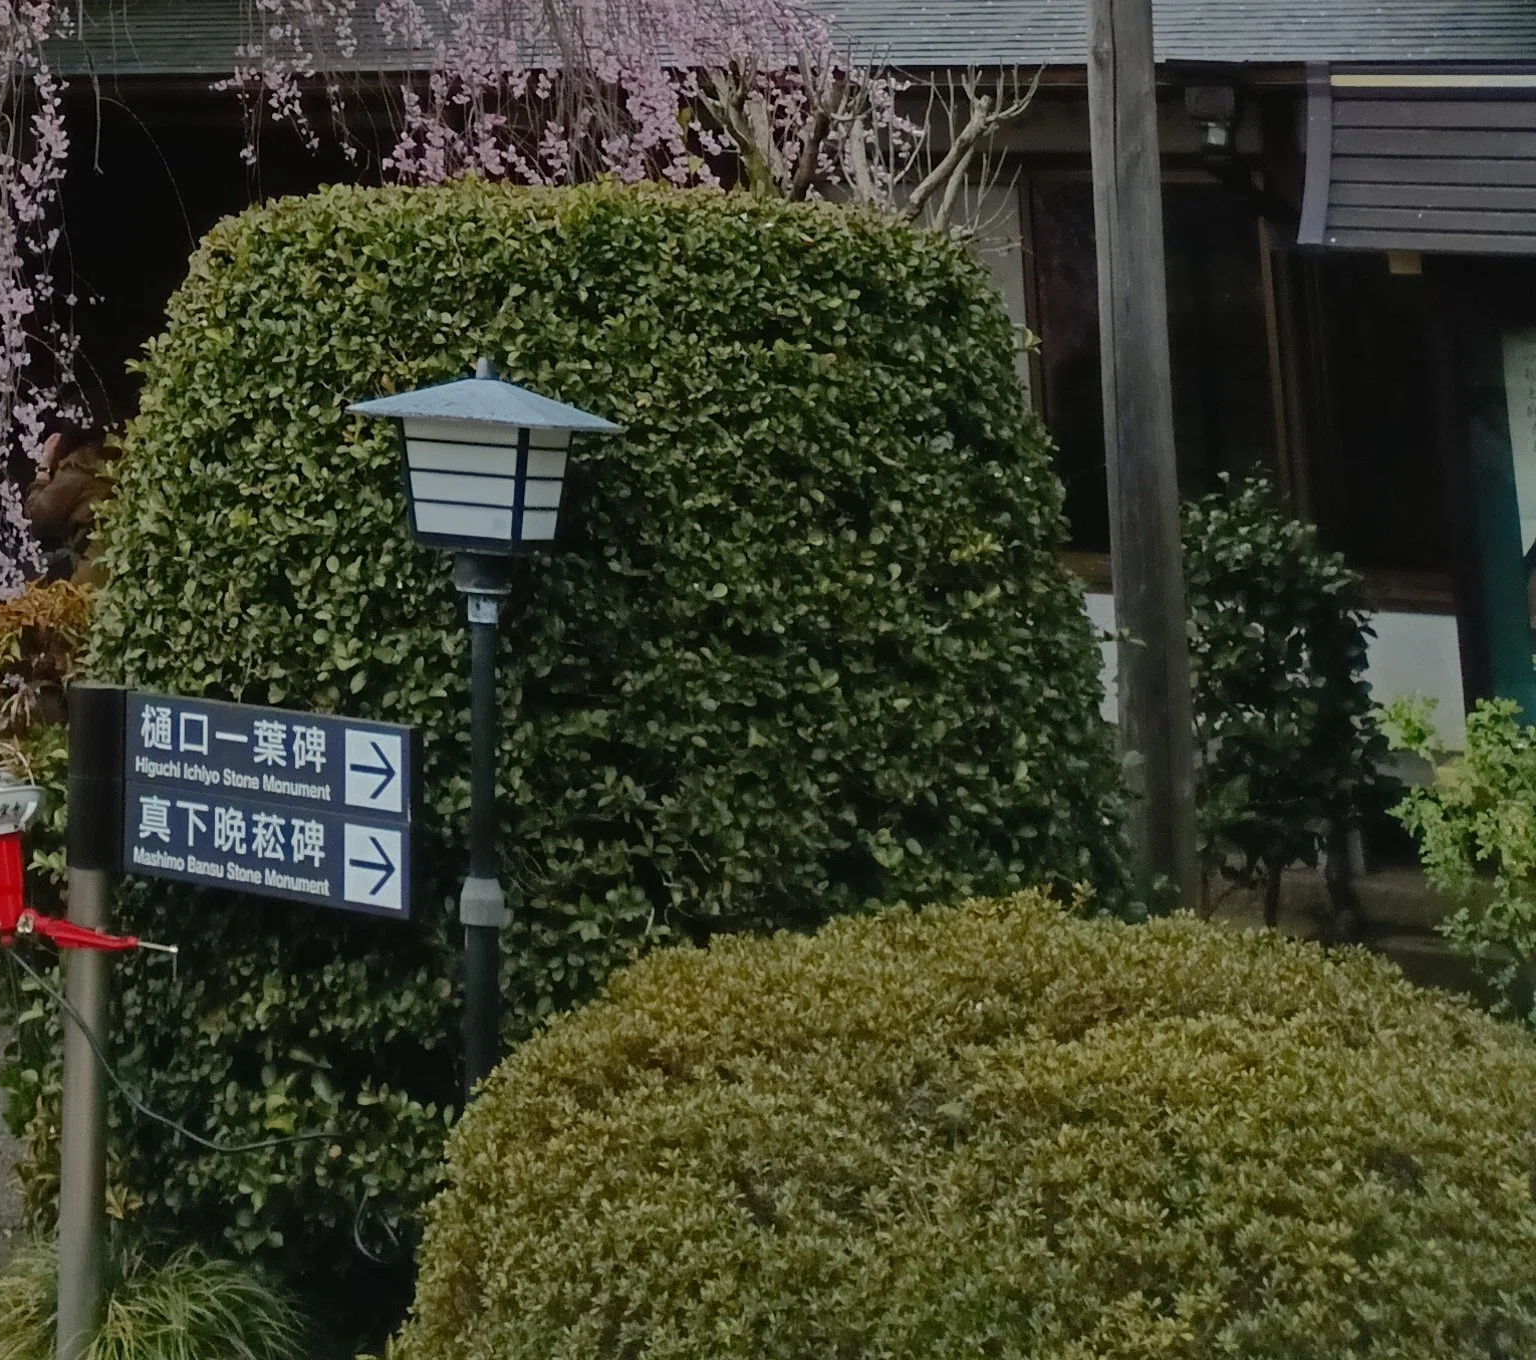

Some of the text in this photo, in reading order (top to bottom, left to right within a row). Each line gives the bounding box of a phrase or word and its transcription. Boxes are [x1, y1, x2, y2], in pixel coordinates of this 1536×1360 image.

[140, 703, 327, 774] 樋口一葉碑
[135, 755, 331, 802] Higuchi Ichiyo Stone Monument
[138, 795, 326, 868] 真下晩菘碑
[133, 846, 331, 897] Mashimo Bansu Stone Monument
